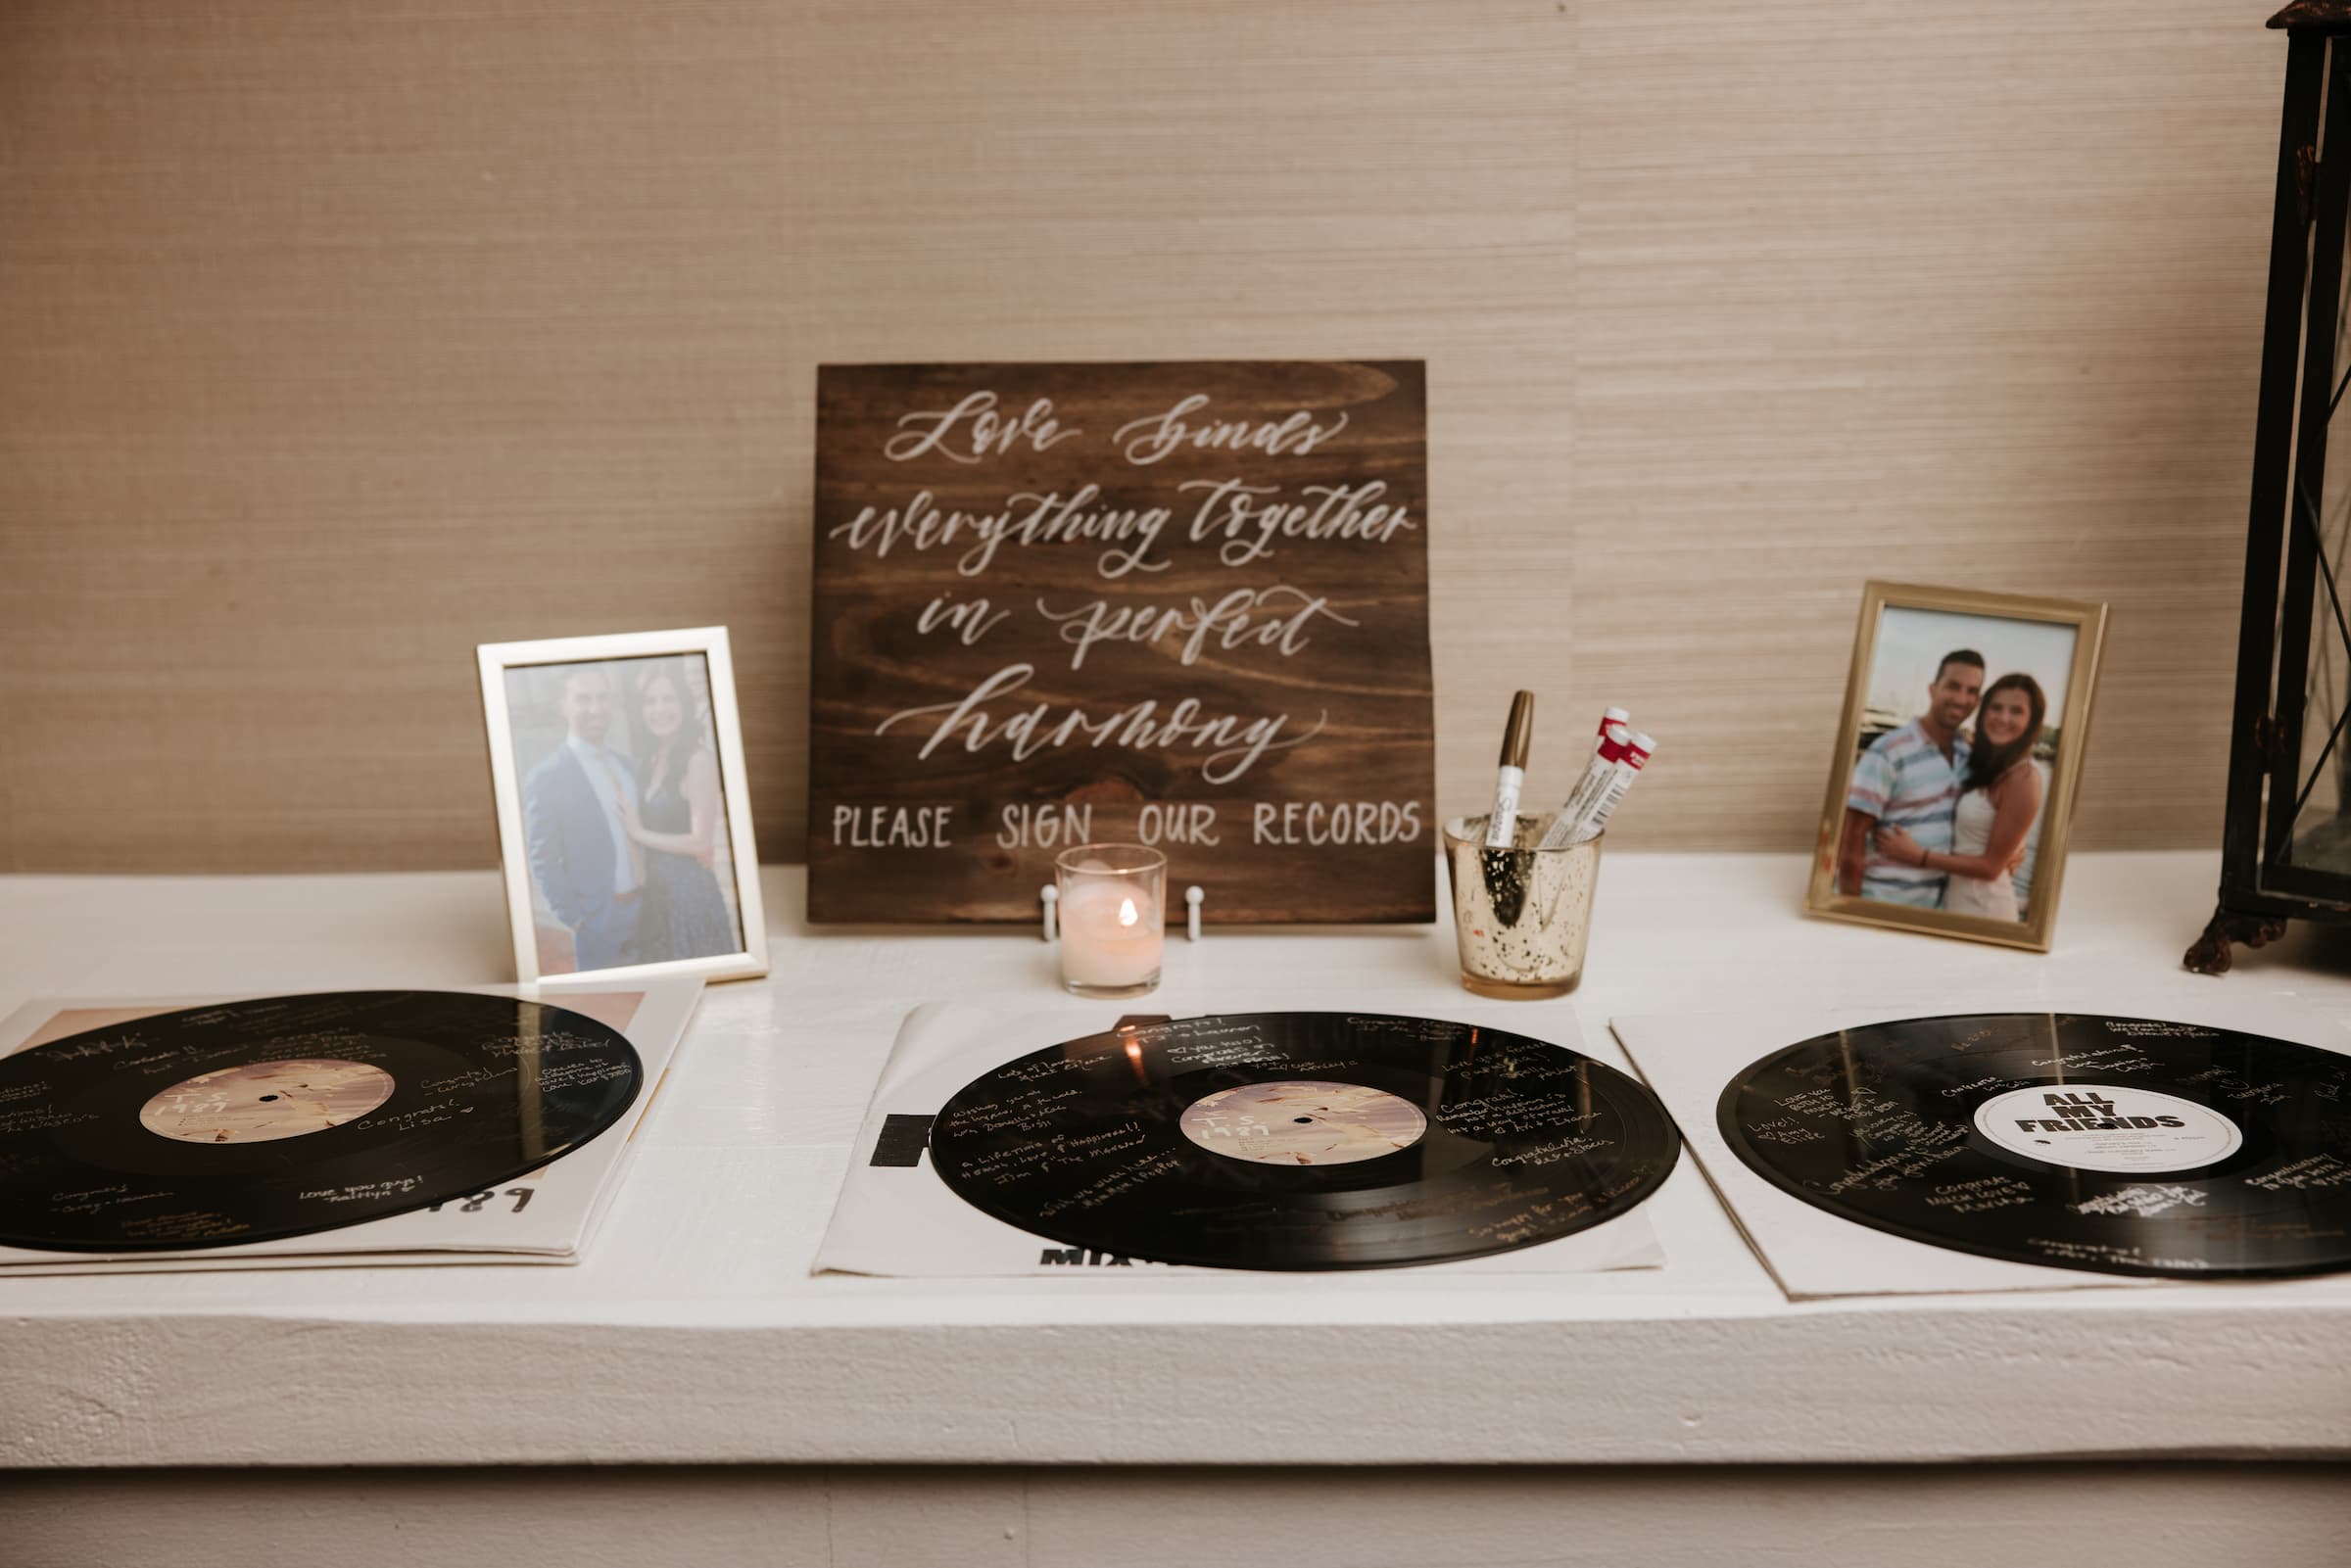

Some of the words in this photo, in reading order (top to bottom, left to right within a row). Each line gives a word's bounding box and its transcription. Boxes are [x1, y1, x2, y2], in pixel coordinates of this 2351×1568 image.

[886, 391, 1080, 463] Love
[1113, 394, 1349, 465] binds
[829, 484, 1173, 578] everything
[1178, 478, 1417, 567] together
[916, 591, 1011, 645] in
[1036, 585, 1361, 671] perfect
[876, 664, 1328, 784] harmony
[832, 805, 953, 848] PLEASE
[997, 803, 1092, 848] SIGN
[1138, 803, 1220, 845] OUR
[1253, 800, 1421, 845] RECORDS
[2014, 1115, 2185, 1133] FRIENDS
[2042, 1091, 2116, 1107] ALL
[2051, 1104, 2118, 1119] MY
